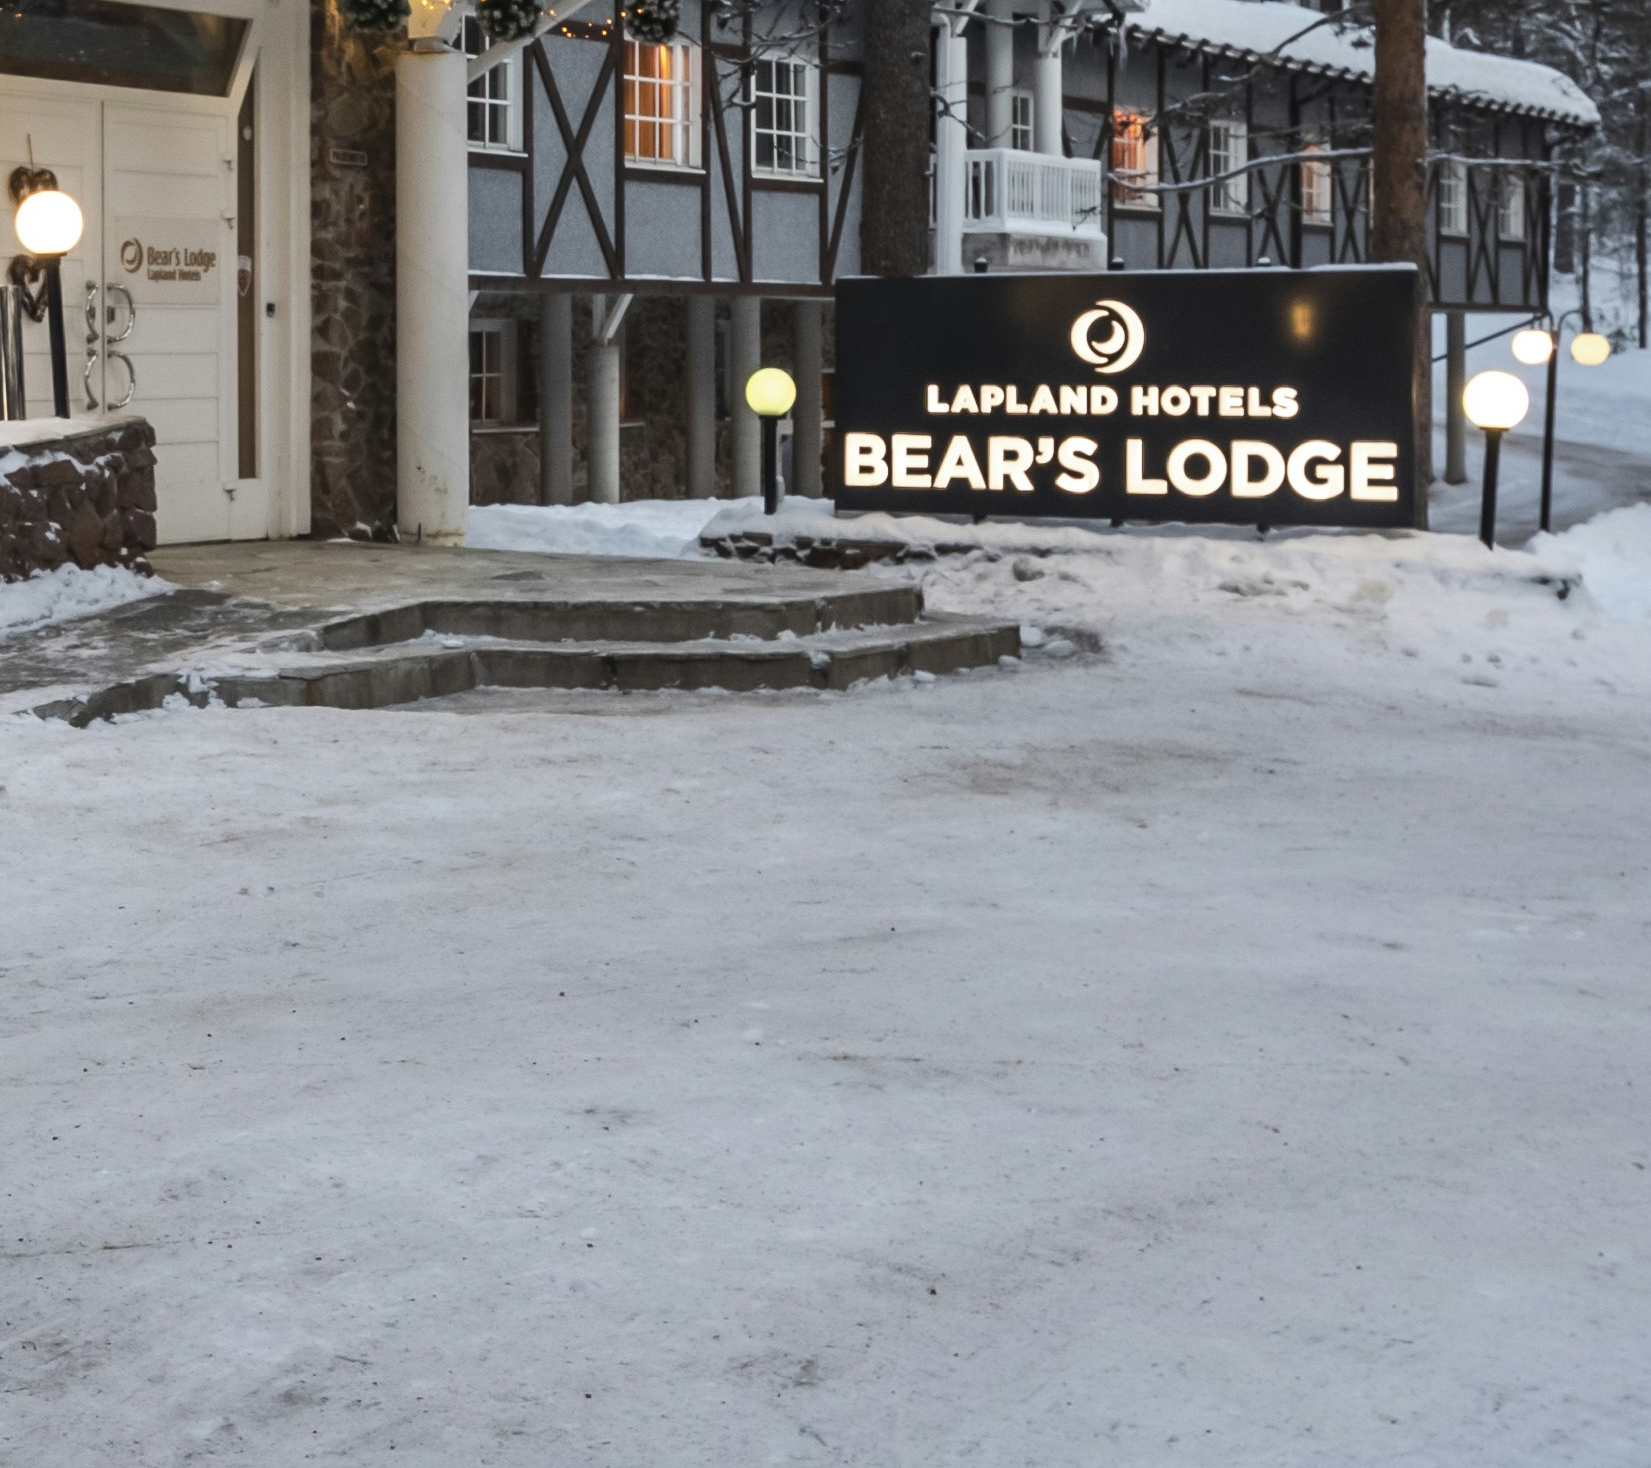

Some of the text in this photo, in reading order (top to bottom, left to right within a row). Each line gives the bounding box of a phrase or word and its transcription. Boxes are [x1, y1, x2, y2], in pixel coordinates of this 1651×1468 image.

[147, 246, 216, 272] Bear's Lodge
[926, 383, 1299, 419] LAPLAND HOTELS
[844, 432, 1399, 502] BEAR'S LODGE
